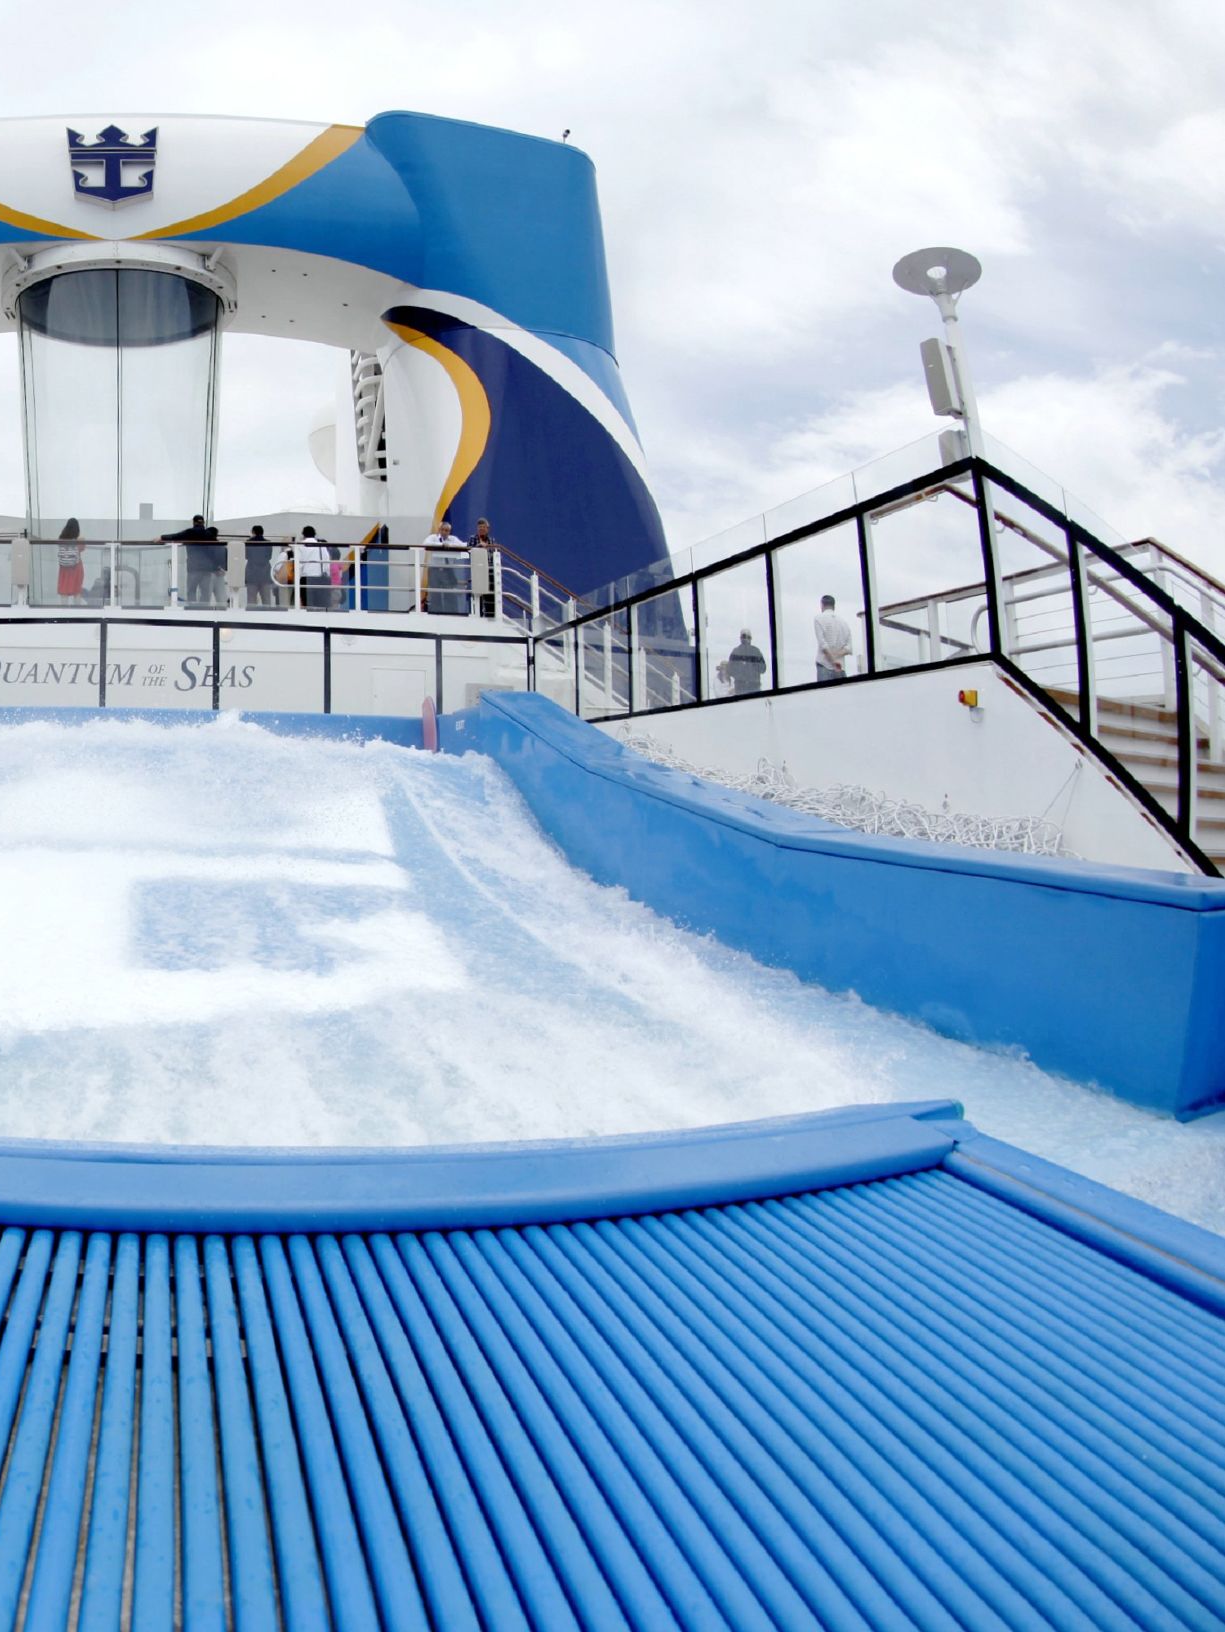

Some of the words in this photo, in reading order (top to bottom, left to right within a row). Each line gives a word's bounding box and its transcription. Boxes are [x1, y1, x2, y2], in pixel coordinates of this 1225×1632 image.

[147, 663, 166, 675] OF
[173, 656, 256, 692] SEAS
[142, 676, 168, 688] THE
